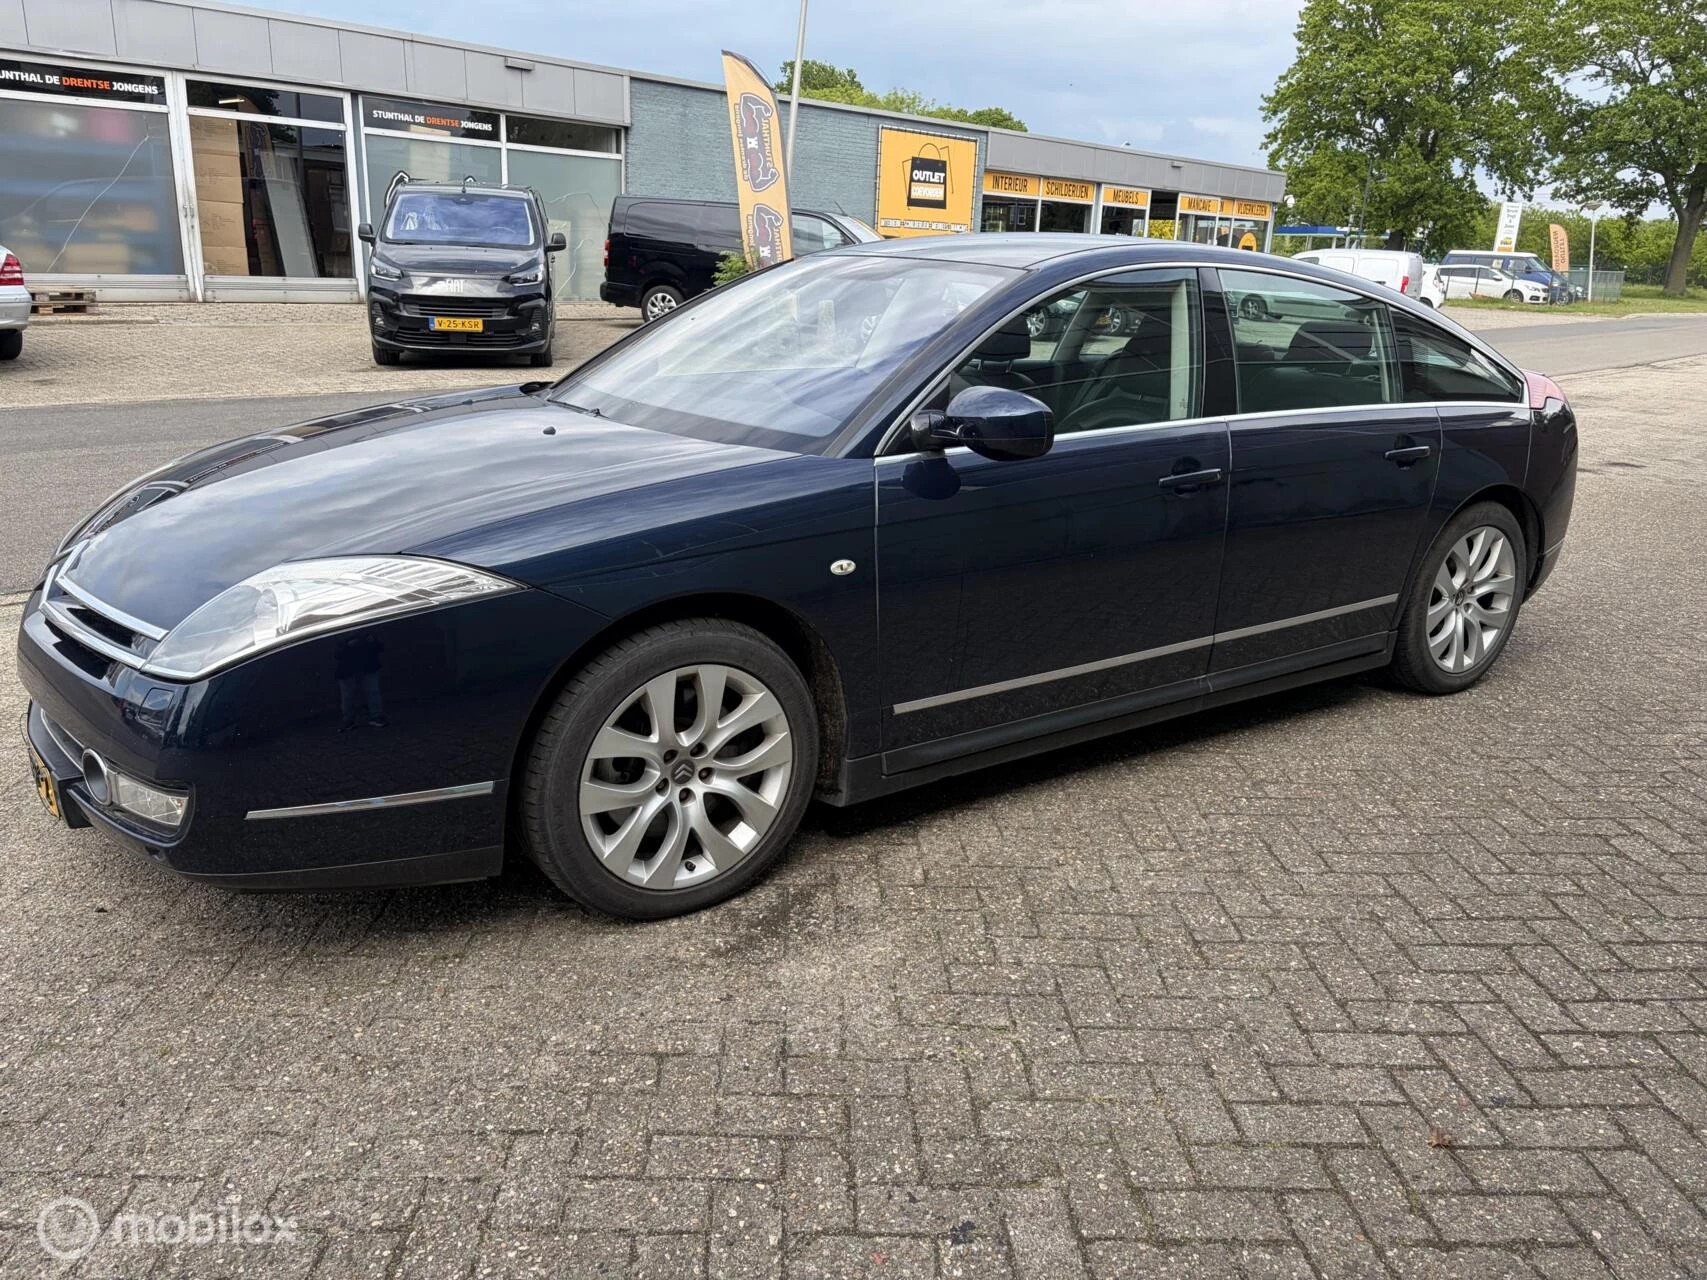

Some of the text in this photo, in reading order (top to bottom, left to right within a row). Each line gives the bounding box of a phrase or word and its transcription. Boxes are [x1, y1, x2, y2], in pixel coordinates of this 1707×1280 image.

[45, 74, 60, 85] DE
[62, 76, 111, 90] DRENTSE
[112, 81, 159, 95] JONGENS
[372, 110, 493, 131] STUNTHAL DE DRENTSE JONGENS
[912, 169, 946, 183] OUTLET
[992, 175, 1028, 193] INTERIEUR
[1046, 181, 1089, 199] SCHILDERIJEN
[1112, 189, 1139, 205] MEUBELS
[1187, 197, 1212, 212] MANCAVE
[446, 278, 465, 293] FIAT
[437, 319, 480, 329] V-25-KSR
